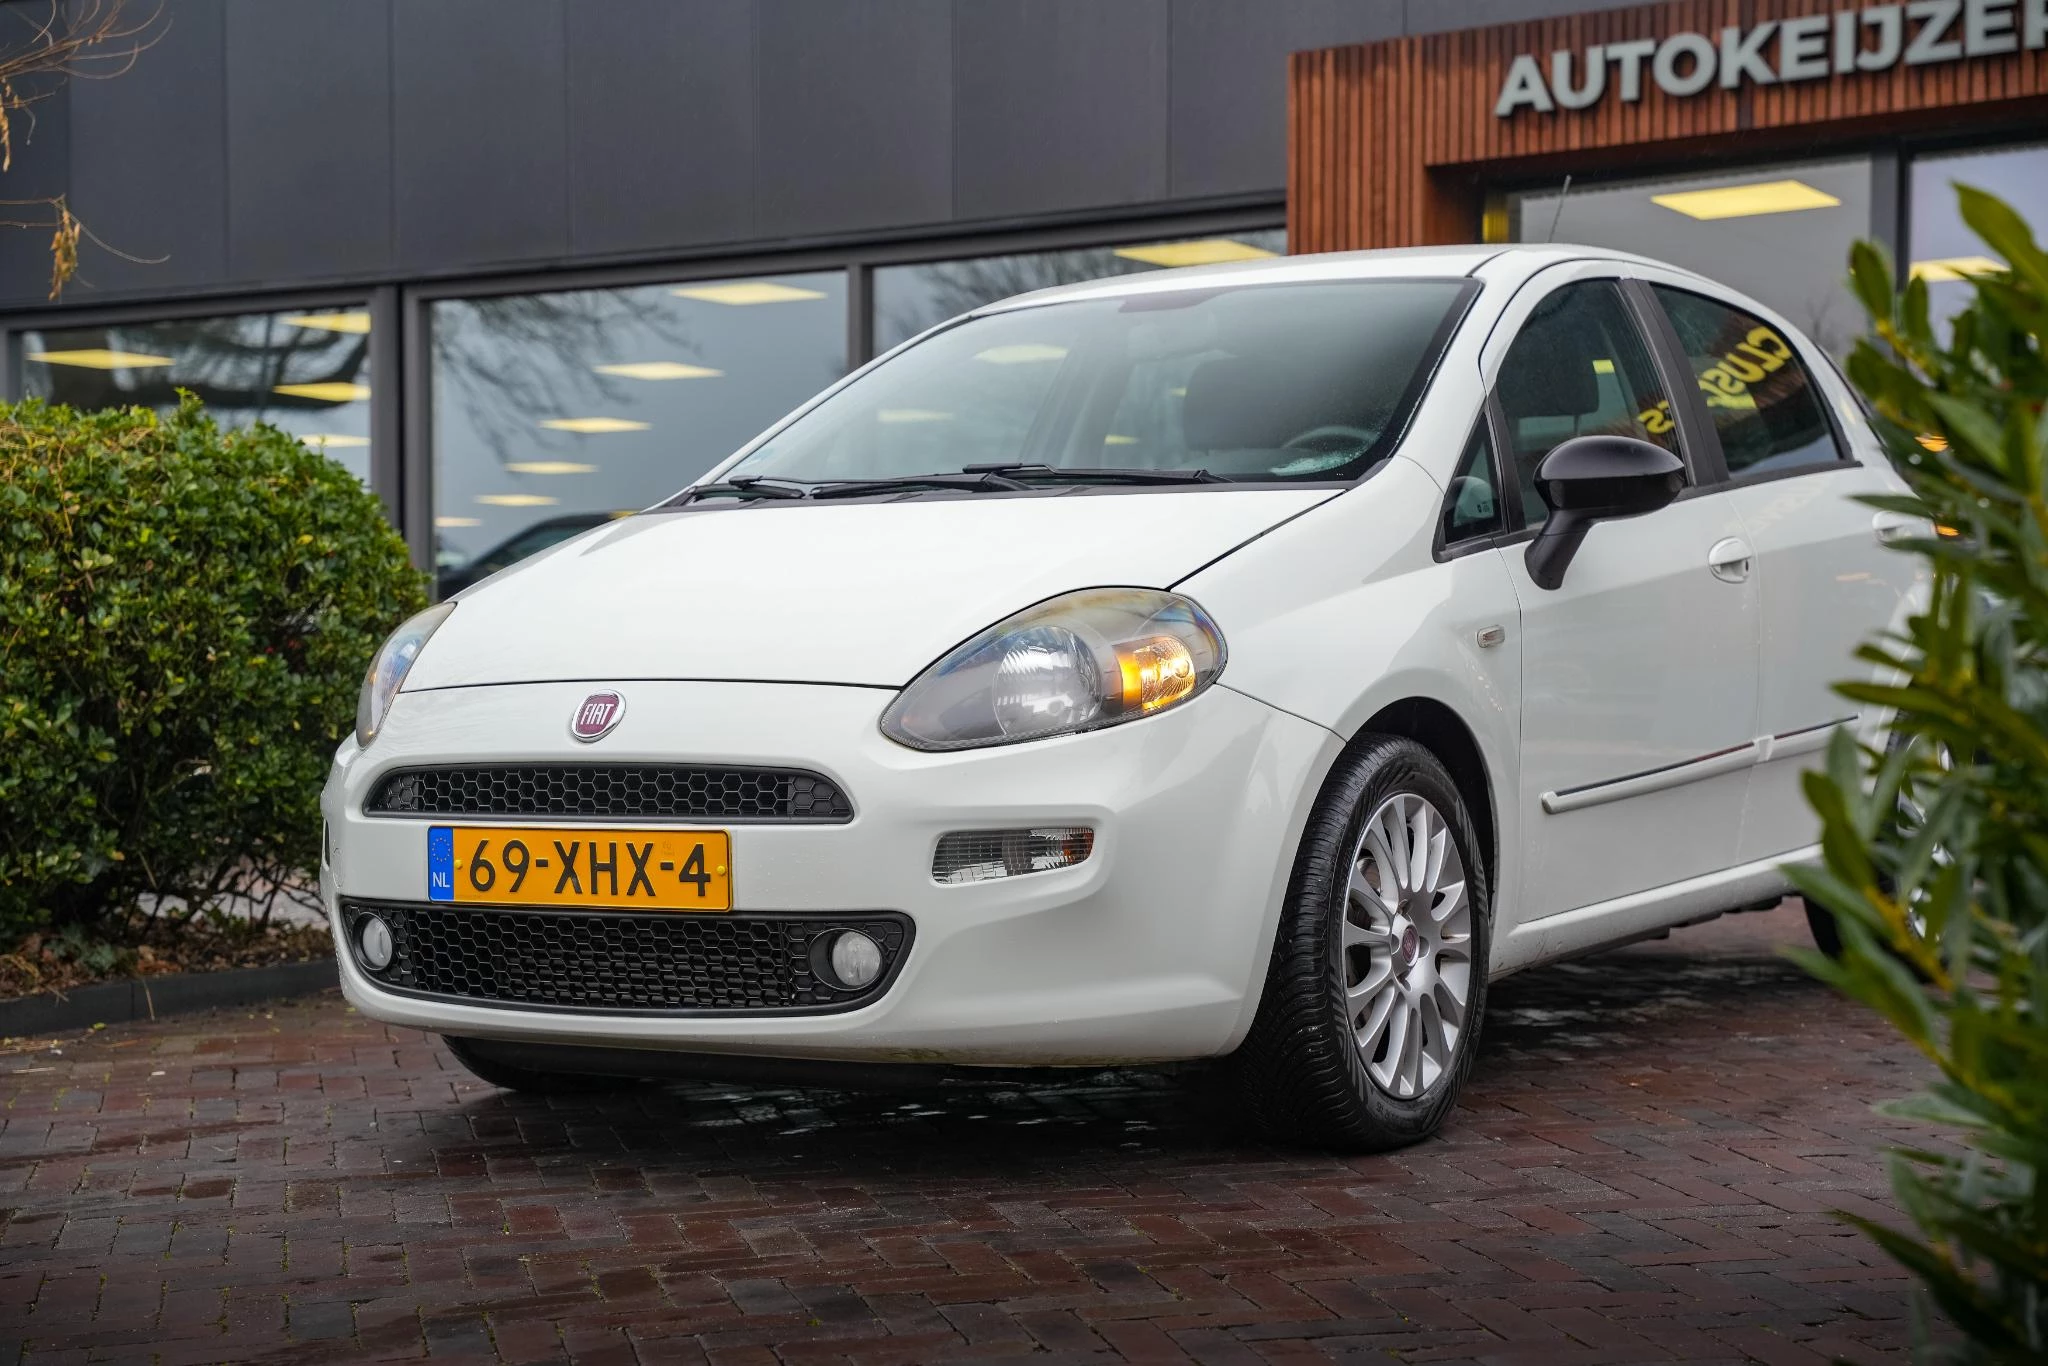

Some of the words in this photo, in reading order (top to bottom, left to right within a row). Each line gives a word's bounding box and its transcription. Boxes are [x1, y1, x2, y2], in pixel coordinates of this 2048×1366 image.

[580, 703, 614, 725] FIAT
[469, 839, 711, 897] 69-XHX-4
[432, 871, 450, 888] NL
